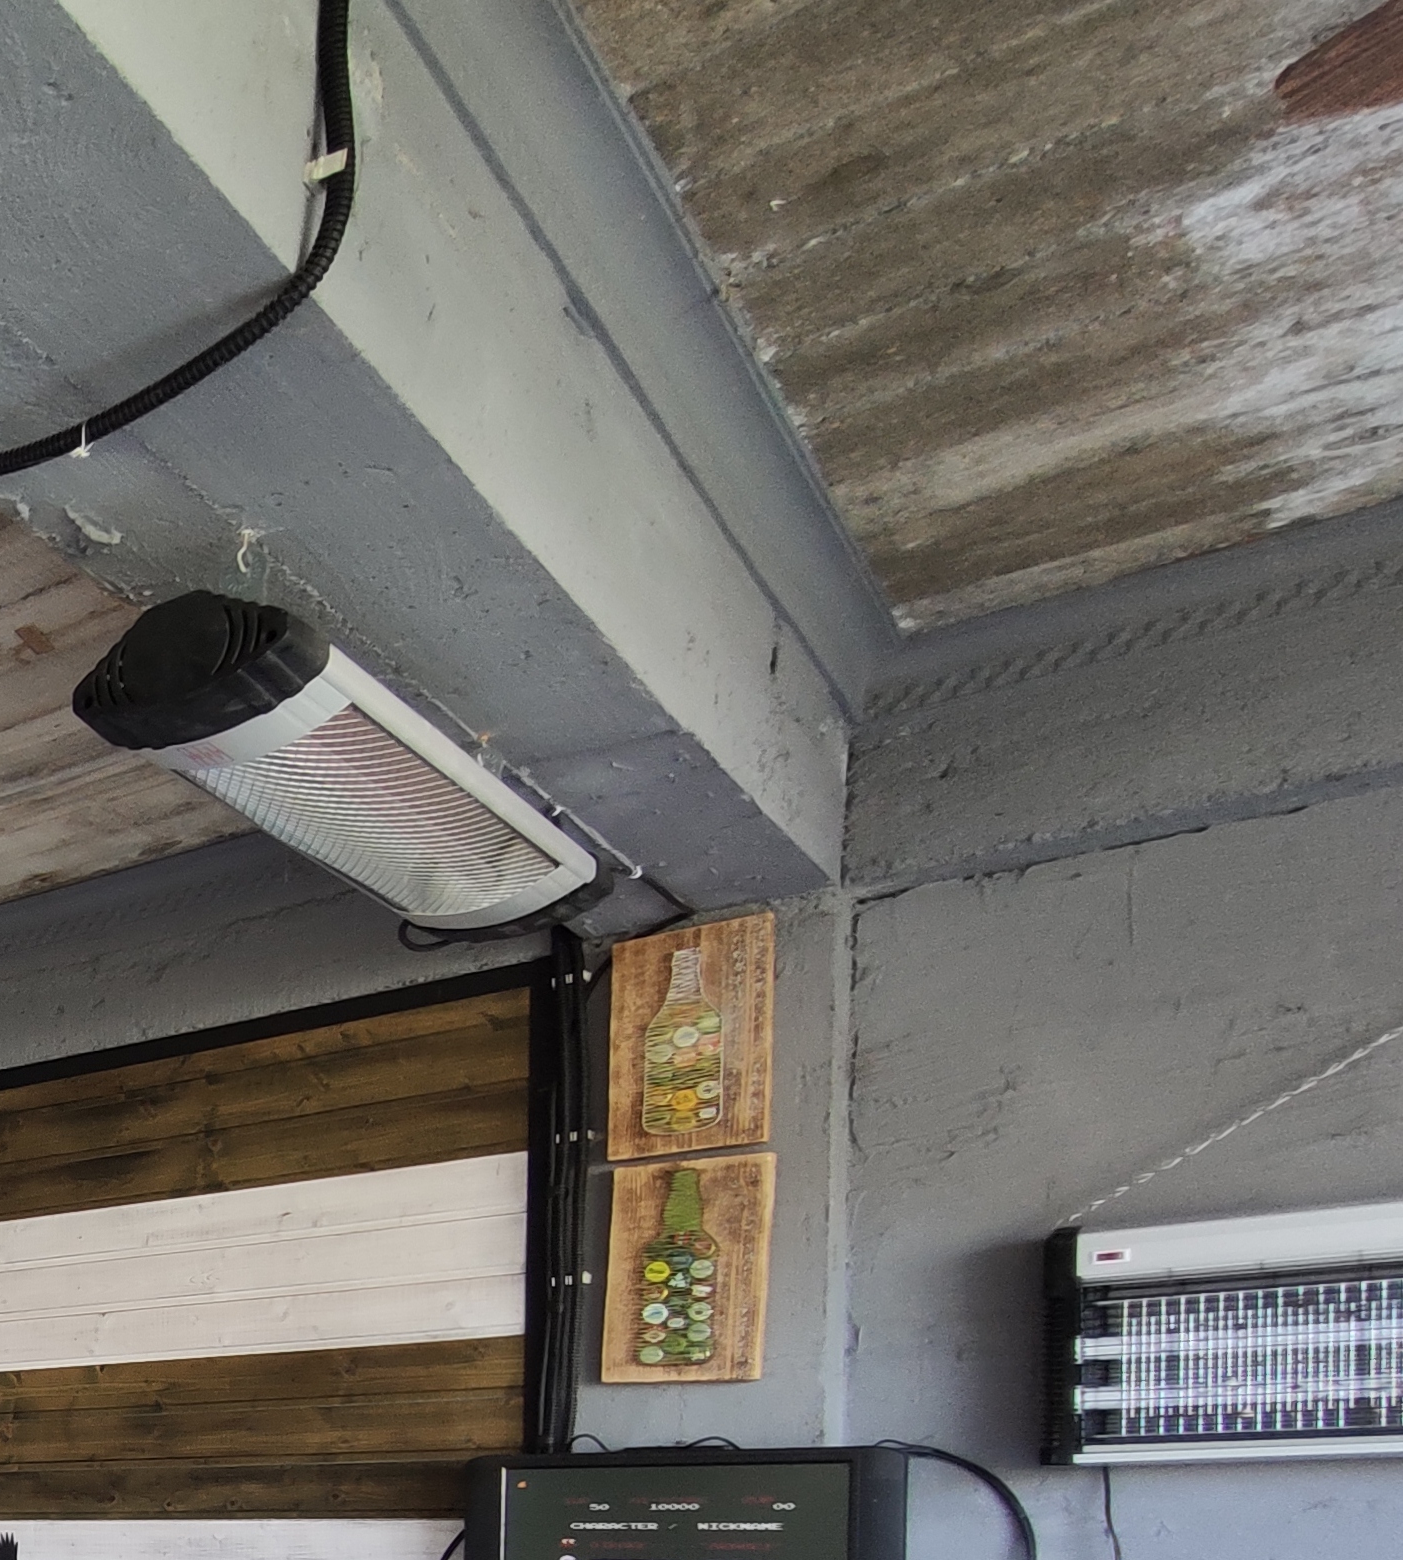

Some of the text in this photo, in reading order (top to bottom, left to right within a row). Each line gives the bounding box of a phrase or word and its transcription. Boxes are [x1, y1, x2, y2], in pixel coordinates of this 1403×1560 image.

[588, 1502, 796, 1511] 50 10000 00
[569, 1522, 659, 1531] CHARACTER
[697, 1522, 784, 1531] NICKNAME
